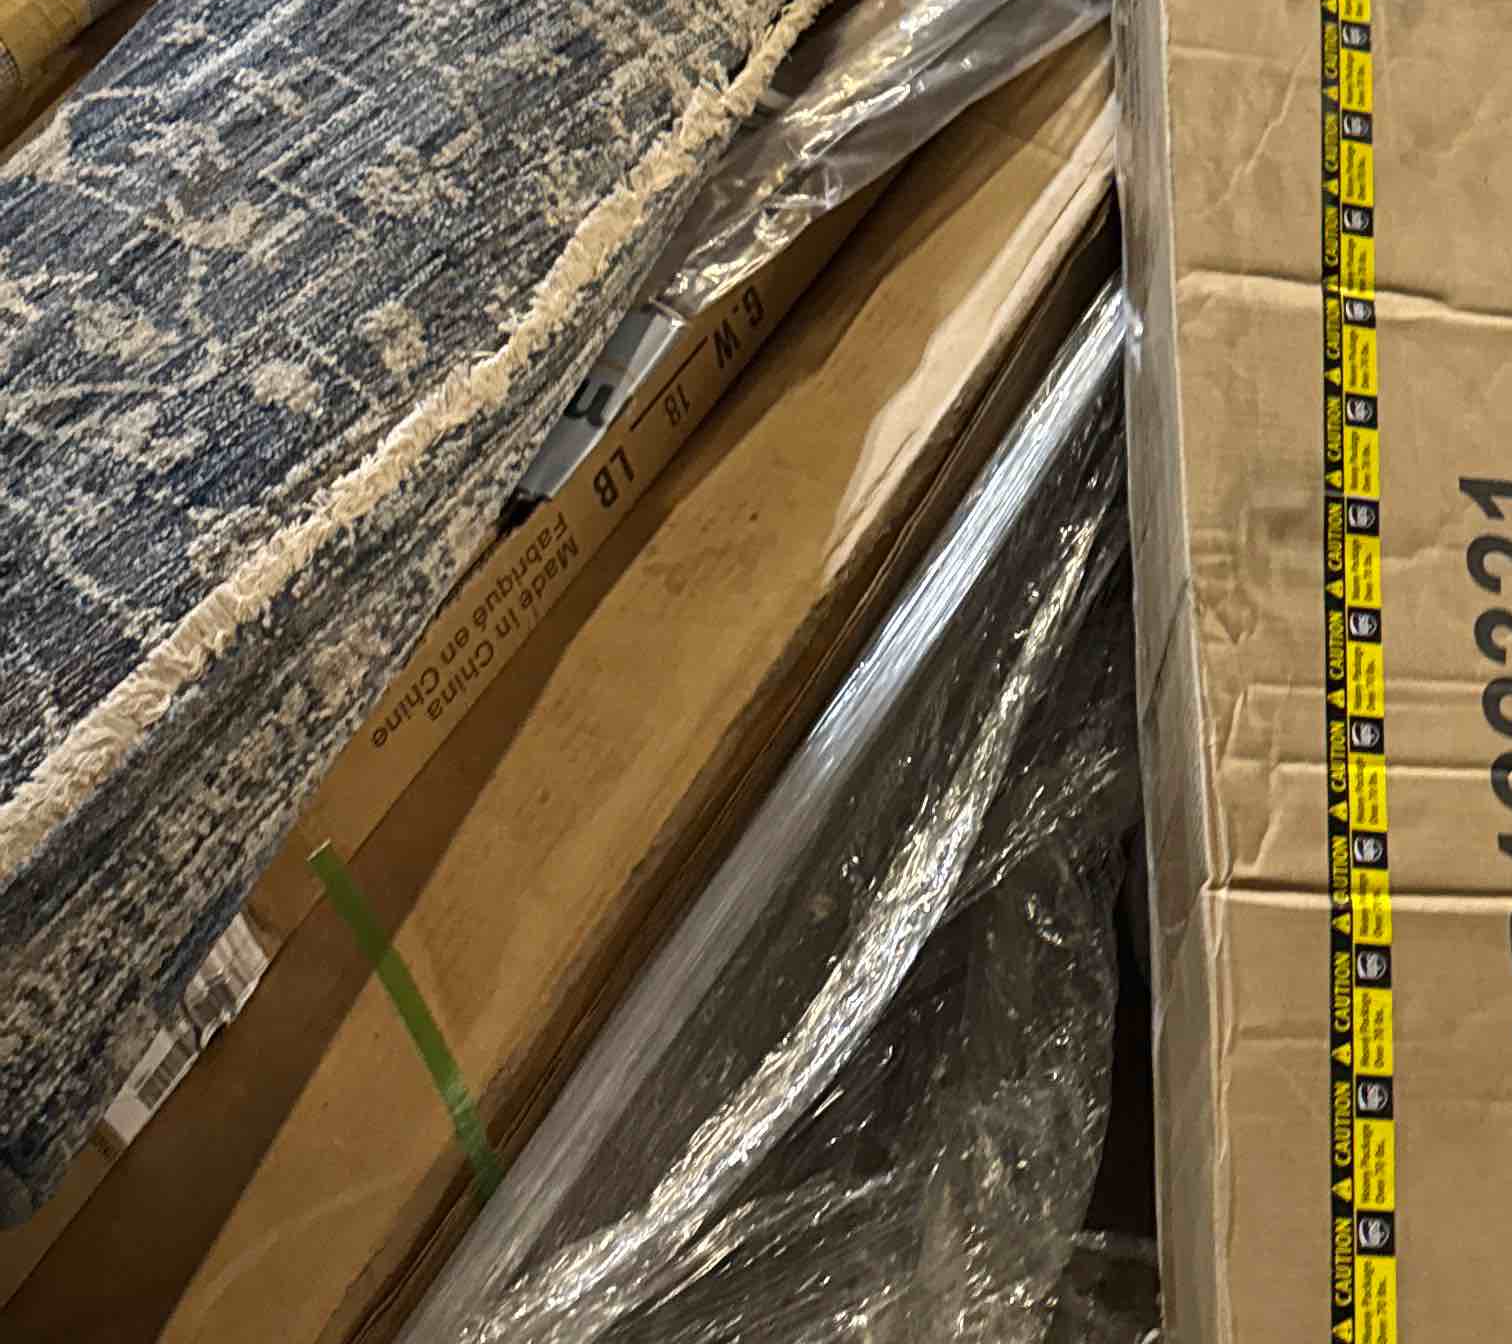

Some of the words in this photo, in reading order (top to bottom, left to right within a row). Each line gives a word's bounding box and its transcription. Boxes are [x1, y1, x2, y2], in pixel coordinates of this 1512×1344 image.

[593, 445, 635, 507] LB
[472, 512, 569, 633] Fabriqué
[519, 536, 579, 609] Made
[426, 640, 495, 721] China
[440, 625, 470, 665] en
[370, 666, 441, 748] Chine
[1334, 1080, 1352, 1167] CAUTION
[1335, 1217, 1353, 1307] CAUTION
